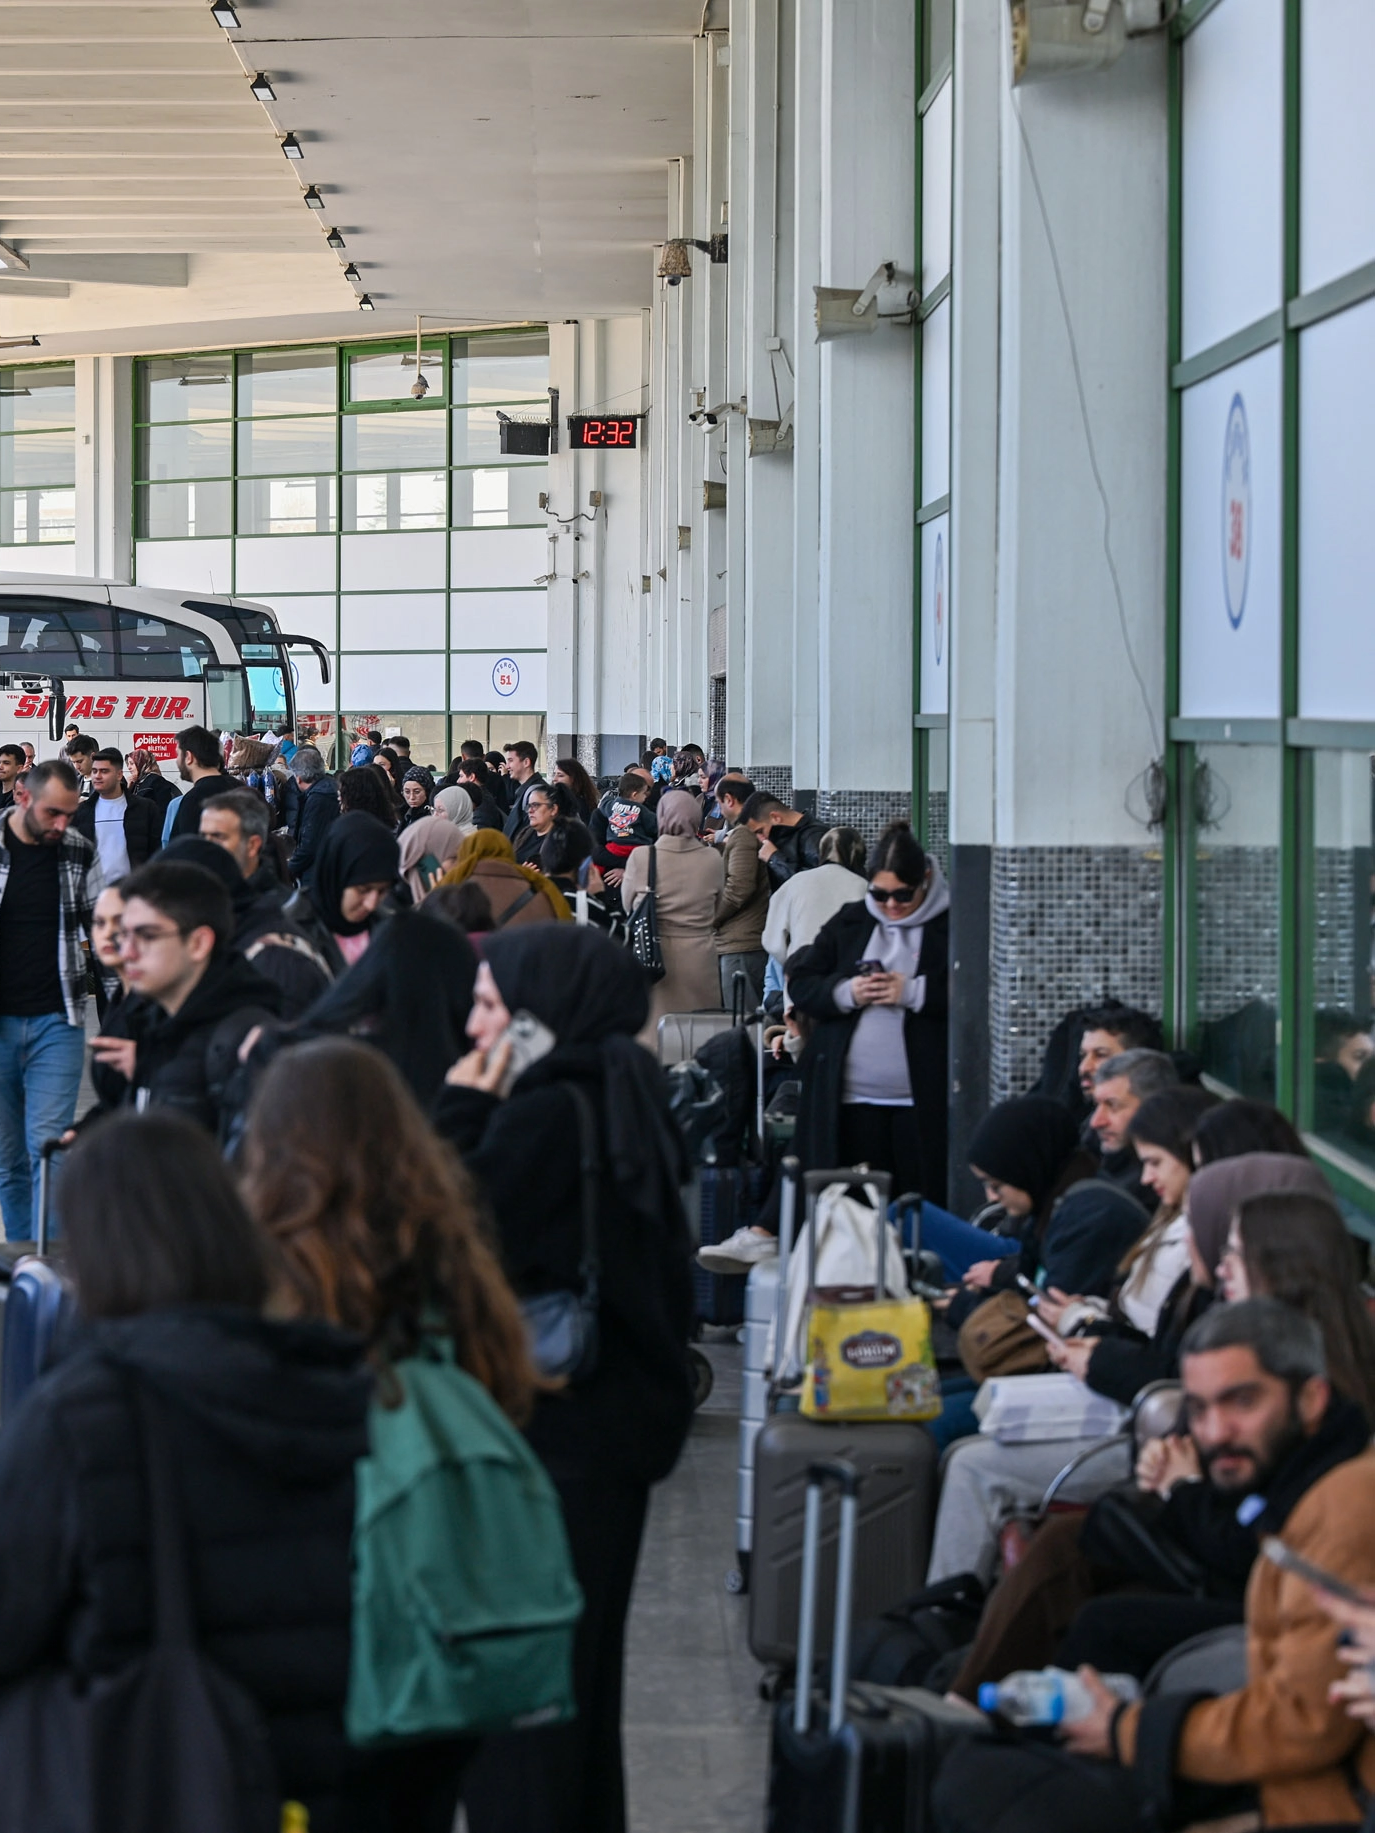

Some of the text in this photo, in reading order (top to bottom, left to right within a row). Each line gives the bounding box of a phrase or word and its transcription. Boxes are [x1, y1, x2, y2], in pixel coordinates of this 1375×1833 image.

[583, 421, 633, 444] 12:32
[496, 661, 516, 673] PERON
[500, 674, 512, 685] 51
[123, 695, 192, 720] TUR
